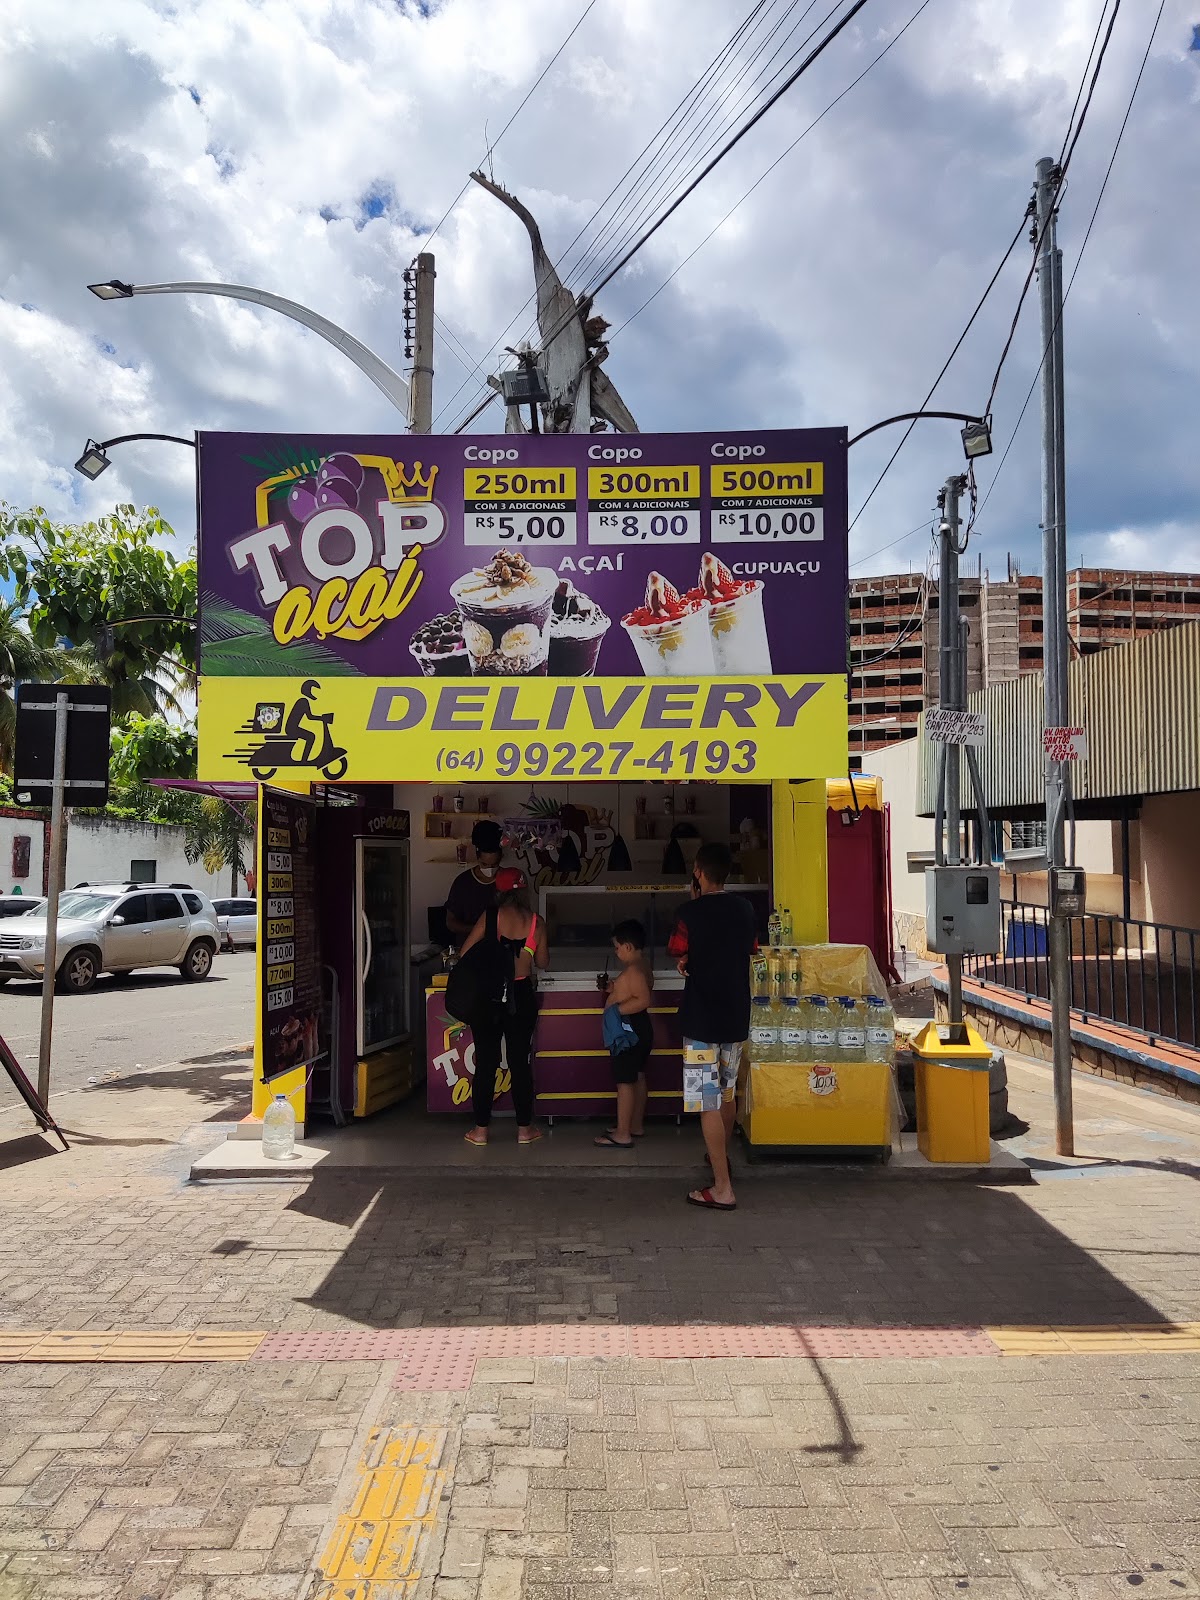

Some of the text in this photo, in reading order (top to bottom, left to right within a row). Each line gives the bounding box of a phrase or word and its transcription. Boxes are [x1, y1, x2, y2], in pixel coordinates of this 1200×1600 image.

[464, 446, 519, 464] Copo
[588, 445, 642, 463] Copo
[711, 443, 766, 460] Copo
[475, 473, 565, 494] 250ml
[600, 472, 689, 493] 300ml
[722, 468, 812, 491] 500ml
[508, 502, 566, 510] ADICIONAIS
[632, 501, 690, 509] ADICIONAIS
[755, 498, 813, 506] ADICIONAIS
[475, 516, 565, 542] R$ 5,00
[599, 515, 688, 540] R$ 8,00
[719, 512, 816, 538] R$ 10,00
[230, 500, 445, 605] TOP
[558, 553, 625, 575] AÇAÍ
[732, 561, 821, 577] CUPUAÇU
[272, 544, 424, 645] açaí
[366, 682, 826, 730] DELIVERY
[925, 709, 939, 720] AV.
[930, 731, 968, 744] CENTRO
[1043, 736, 1070, 745] SANTOS
[436, 739, 758, 777] (64) 99227-4193
[1050, 752, 1079, 761] CENTRO
[367, 815, 386, 833] TOP
[275, 855, 290, 869] 5,00
[271, 877, 291, 889] 300ml
[276, 901, 292, 915] 8,00
[270, 922, 293, 935] 500ml
[274, 945, 293, 960] 10,00
[269, 966, 292, 981] 770ml
